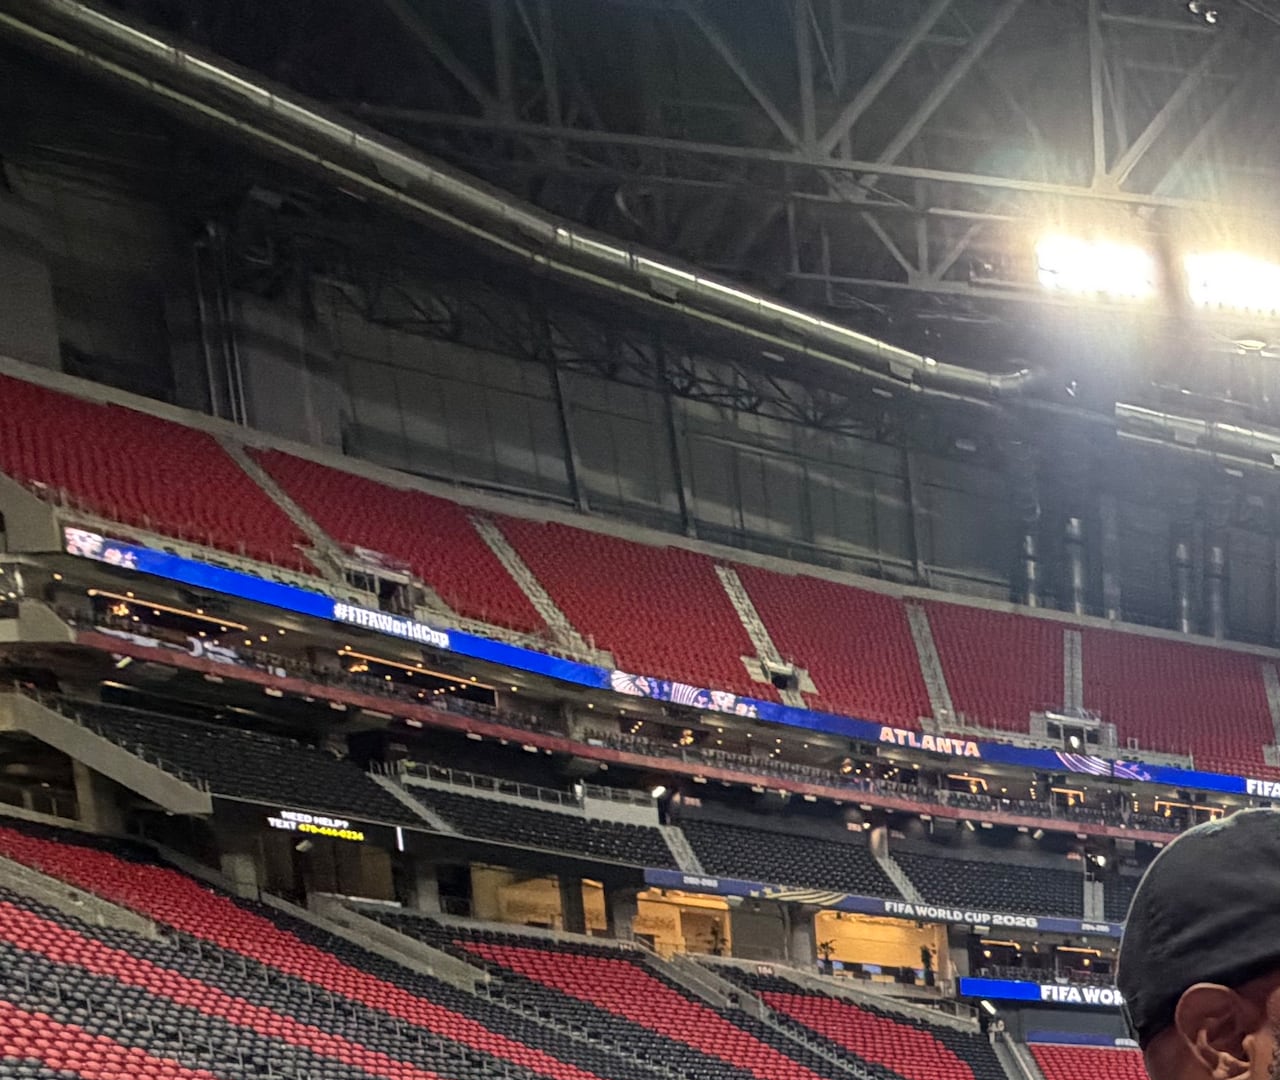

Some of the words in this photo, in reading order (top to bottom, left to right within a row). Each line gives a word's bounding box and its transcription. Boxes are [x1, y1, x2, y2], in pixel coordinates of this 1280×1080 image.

[333, 602, 450, 649] #FIFAWorldCup
[879, 726, 981, 758] ATLANTA
[266, 817, 297, 831] TEXT
[883, 901, 914, 916] FIFA
[915, 905, 964, 922] WORLD
[964, 911, 991, 924] CUP
[992, 915, 1039, 929] 2026
[1040, 984, 1081, 1003] FIFA
